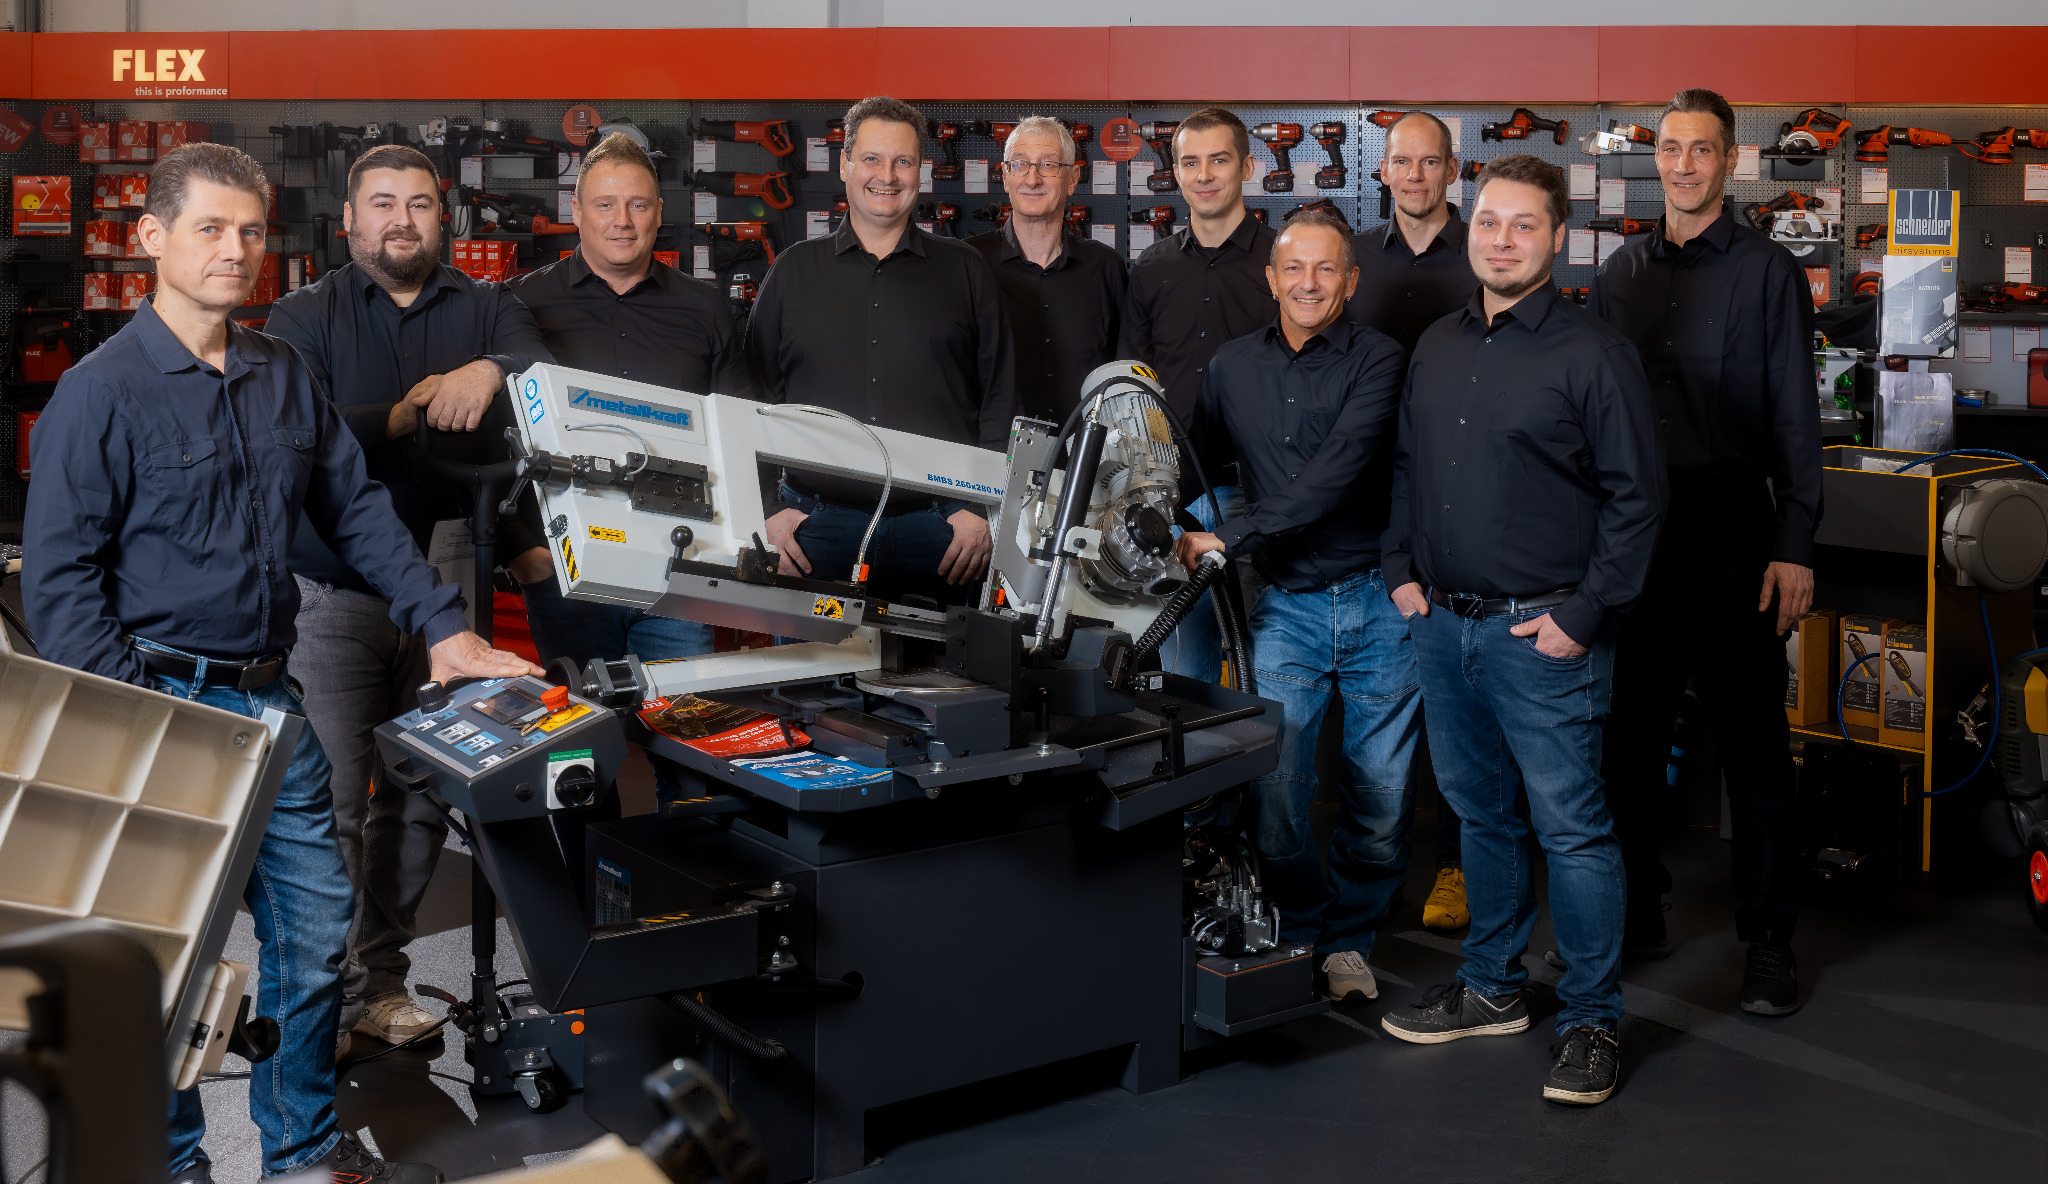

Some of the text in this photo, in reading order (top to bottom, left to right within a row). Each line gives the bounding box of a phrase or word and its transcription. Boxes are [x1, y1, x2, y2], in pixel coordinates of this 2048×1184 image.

[113, 49, 206, 82] FLEX
[135, 86, 228, 98] this is proformance
[579, 111, 585, 119] 3
[1118, 125, 1125, 133] 3
[1894, 246, 1951, 256] airsystems
[587, 395, 689, 426] metallkraft
[927, 473, 953, 486] BMBS
[955, 479, 992, 494] 260x280
